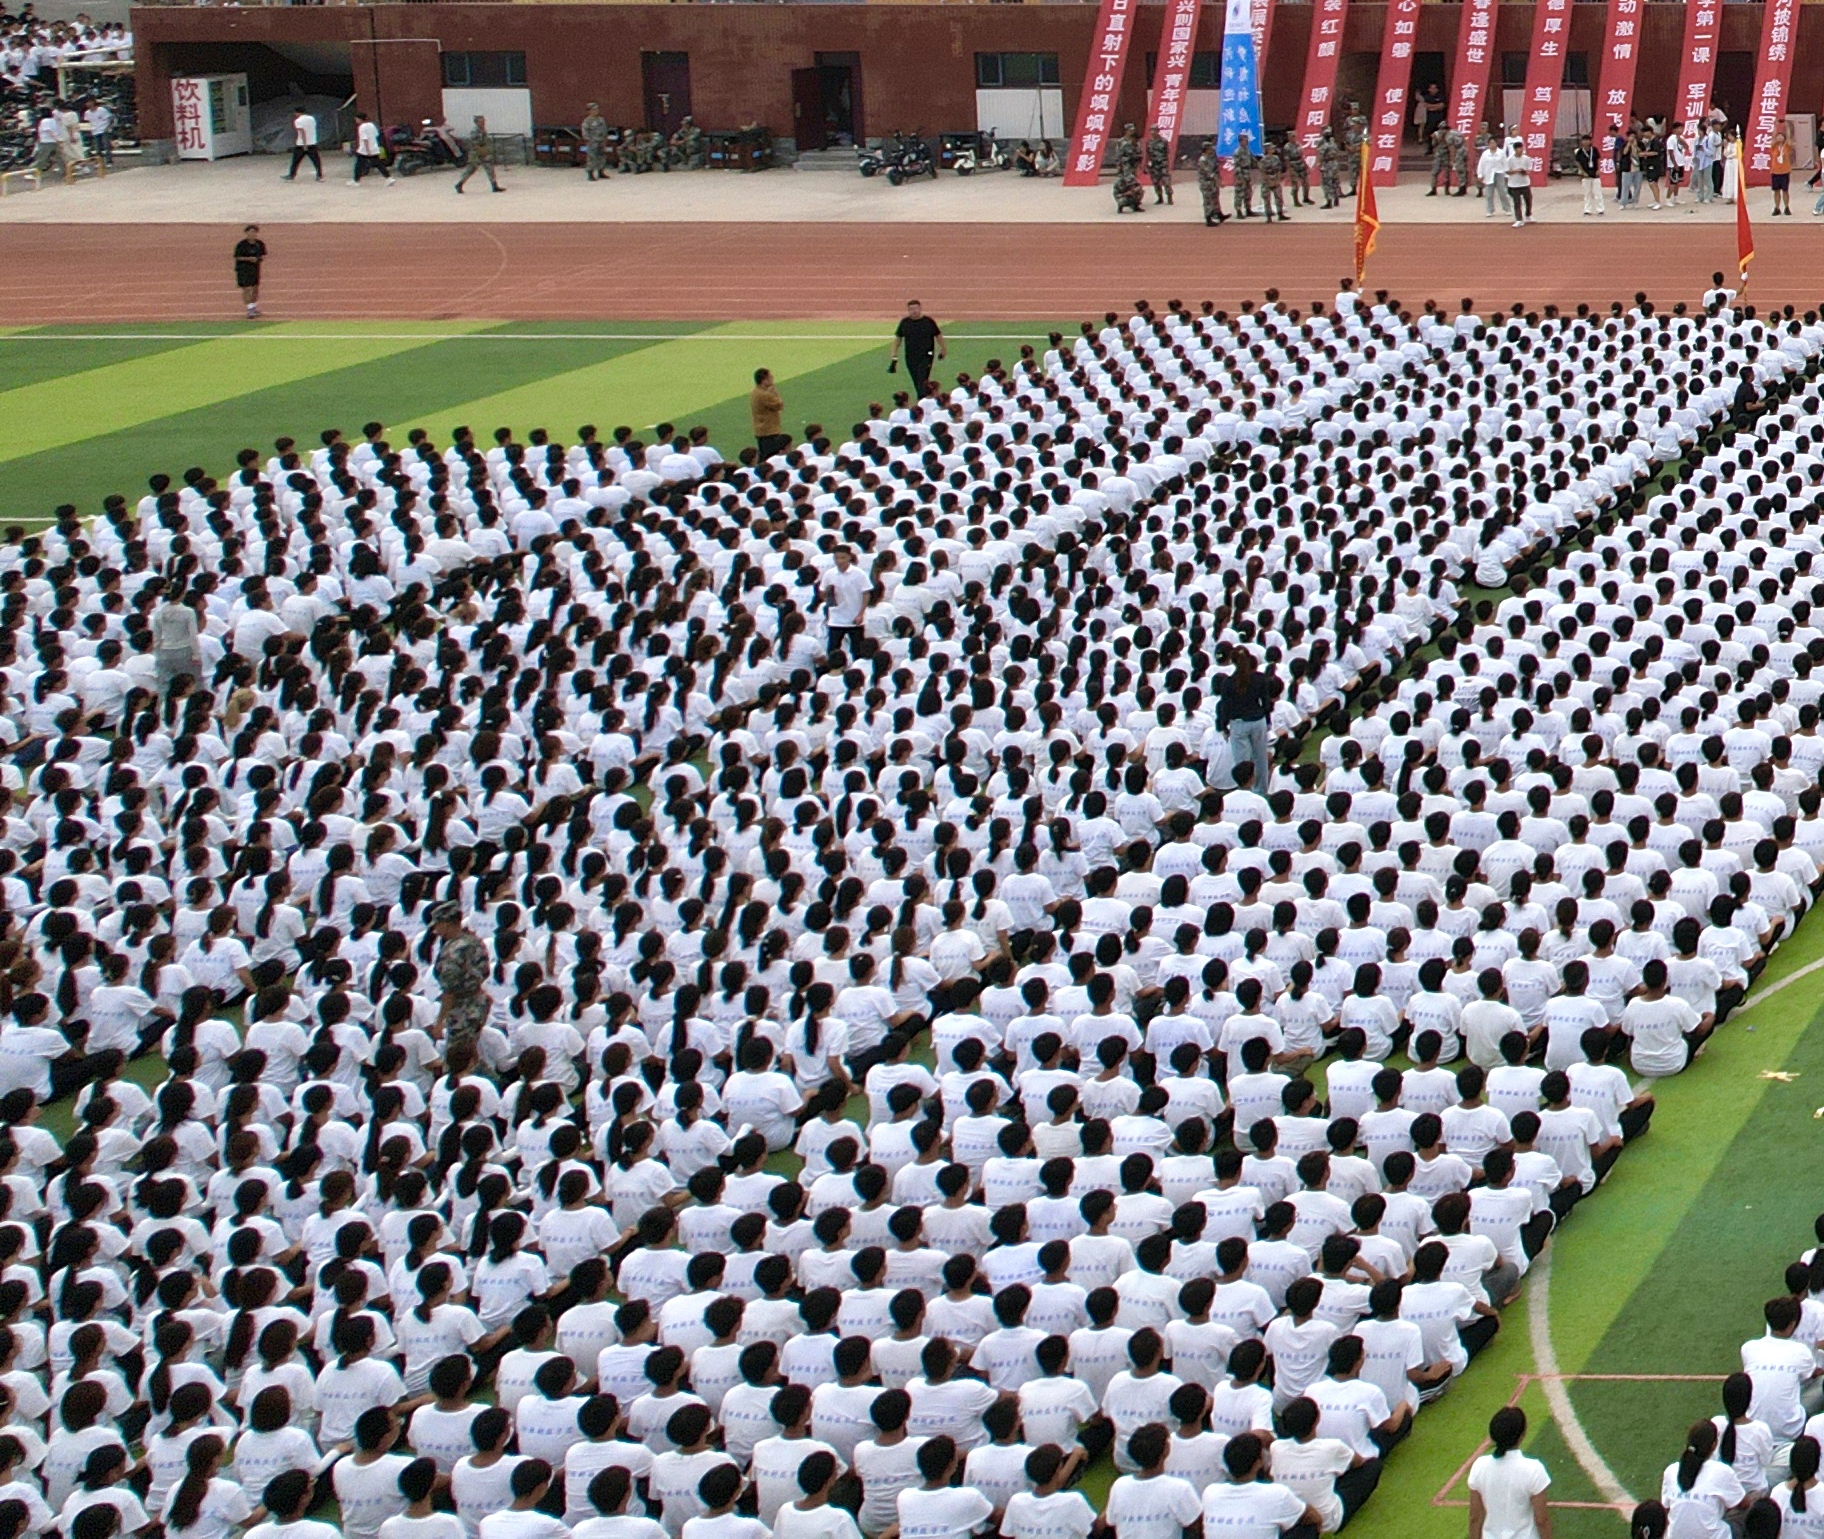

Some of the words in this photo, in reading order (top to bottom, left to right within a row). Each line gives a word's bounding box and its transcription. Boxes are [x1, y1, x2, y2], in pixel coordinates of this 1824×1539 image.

[175, 80, 206, 151] 饮料机
[1158, 74, 1184, 143] 青年强则国
[1373, 87, 1403, 172] 使命在肩
[1750, 80, 1781, 171] 盛世写华章
